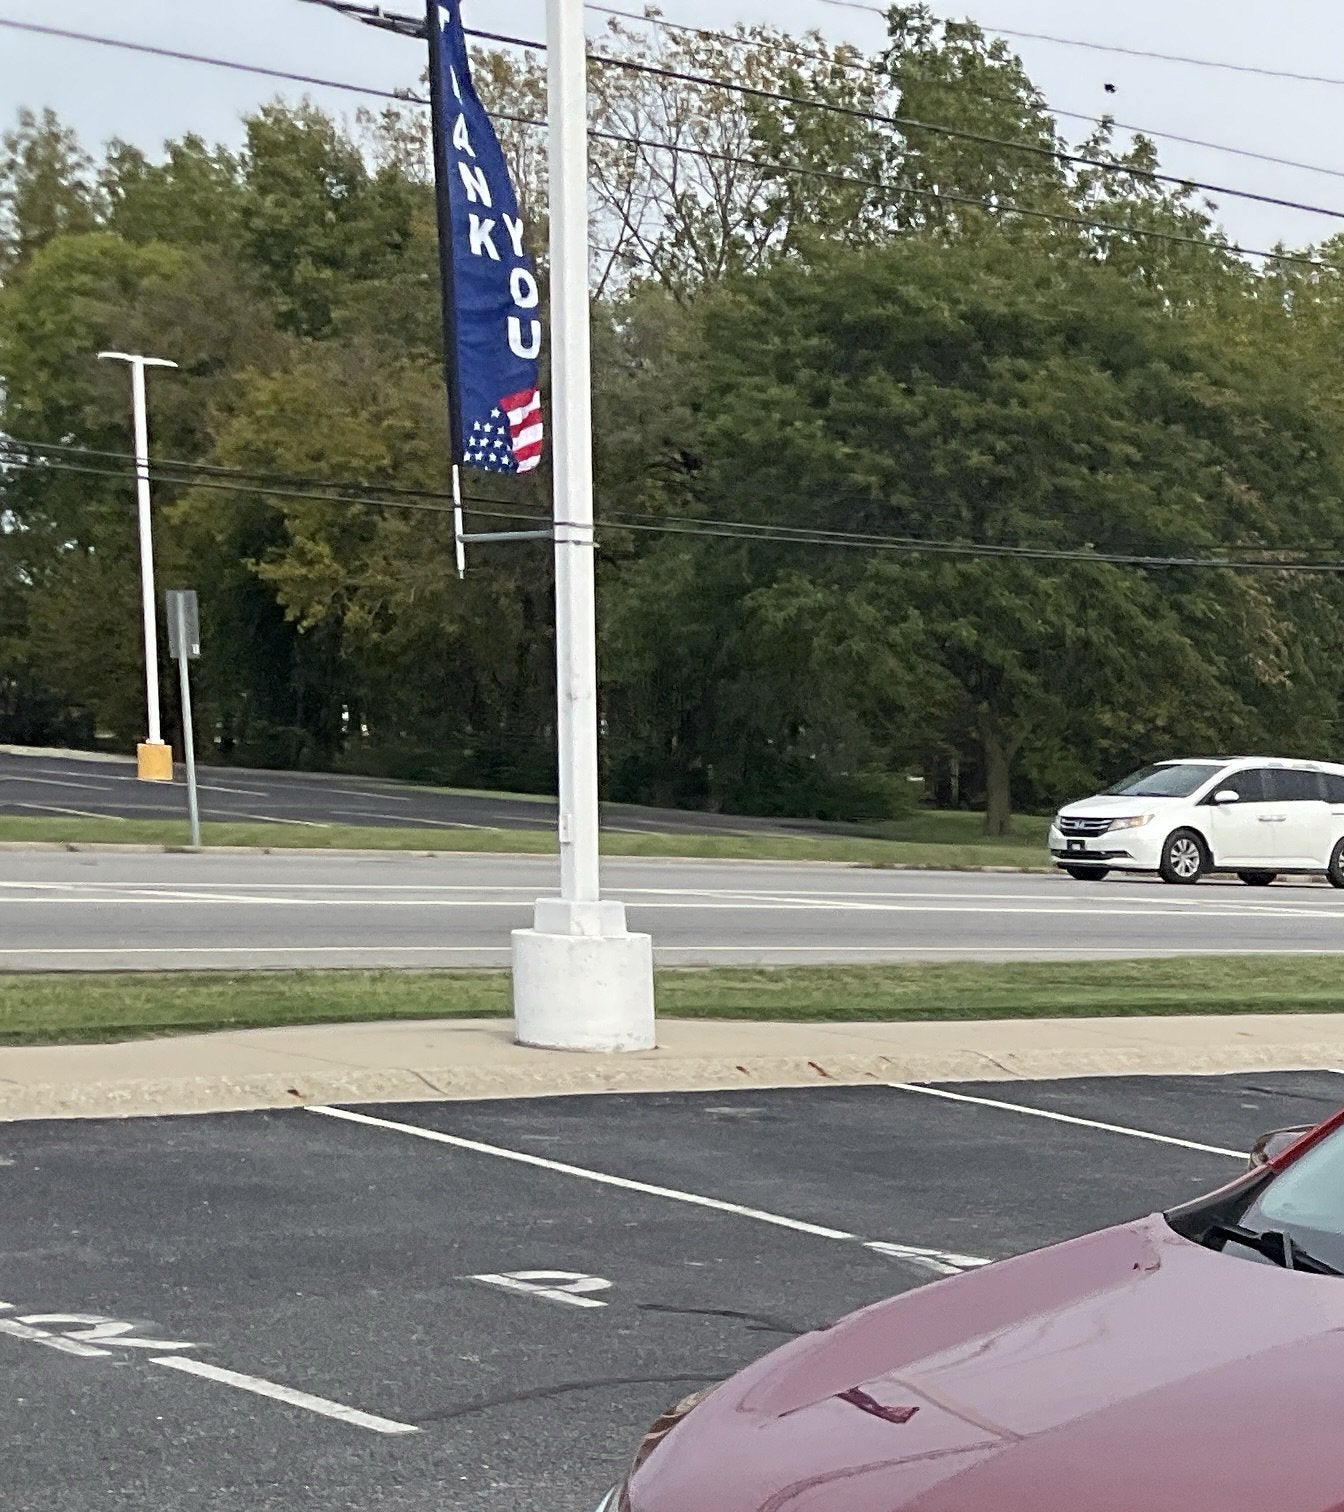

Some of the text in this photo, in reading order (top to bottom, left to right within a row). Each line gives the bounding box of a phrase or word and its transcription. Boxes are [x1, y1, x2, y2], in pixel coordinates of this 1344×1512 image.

[437, 5, 499, 261] ANK
[503, 212, 541, 359] YOU
[464, 1270, 613, 1308] P
